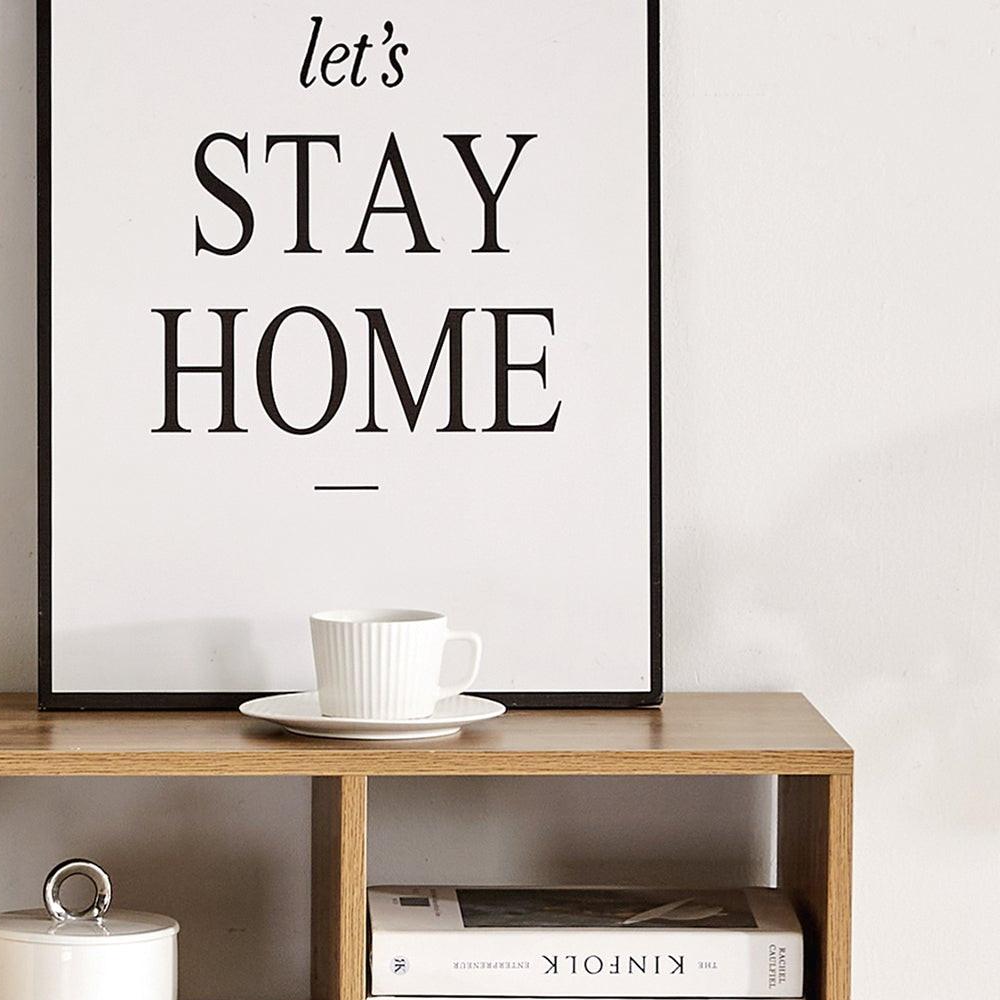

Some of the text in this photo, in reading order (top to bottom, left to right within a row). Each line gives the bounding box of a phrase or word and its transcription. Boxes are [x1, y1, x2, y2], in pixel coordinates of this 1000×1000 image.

[194, 131, 539, 256] STAY
[150, 305, 562, 435] HOME
[542, 955, 685, 974] KINFOLK
[697, 961, 718, 969] THE
[778, 947, 786, 985] RACHEL
